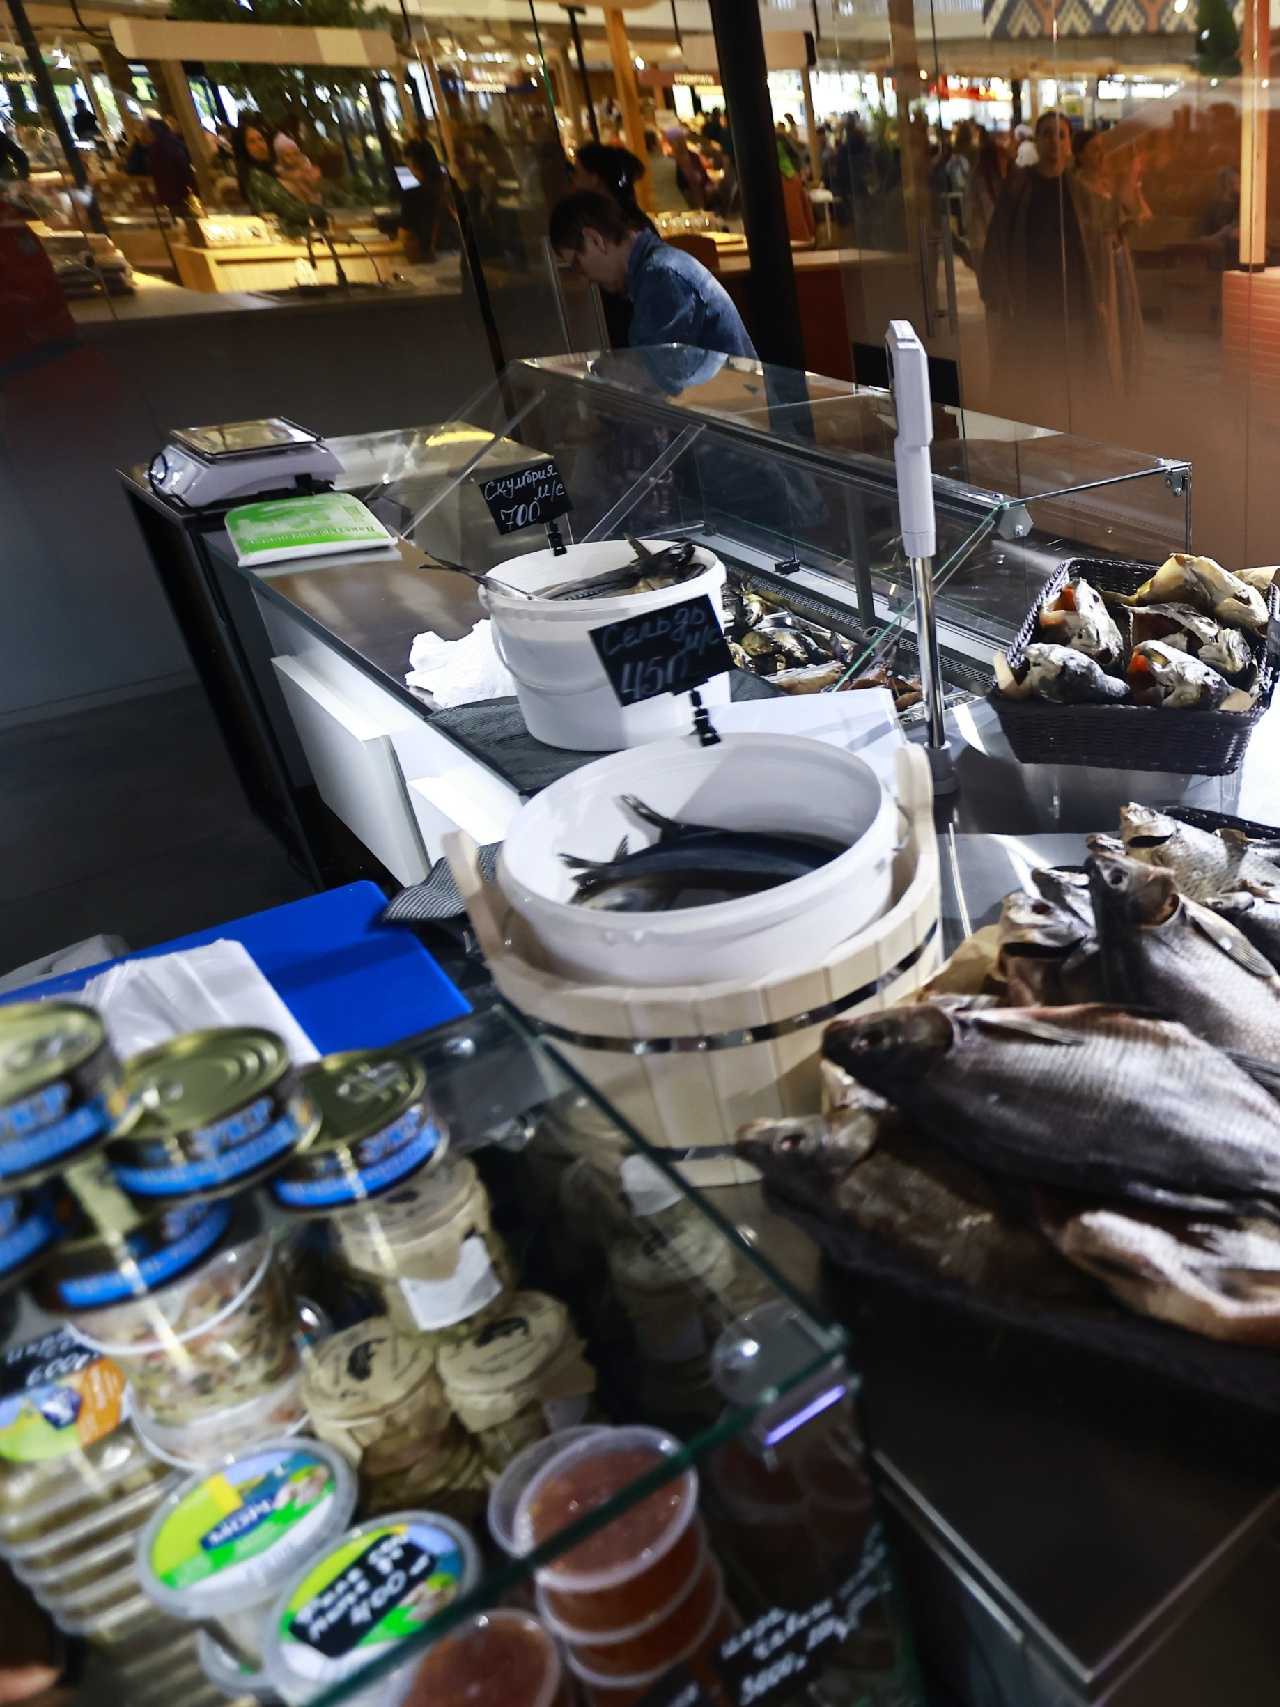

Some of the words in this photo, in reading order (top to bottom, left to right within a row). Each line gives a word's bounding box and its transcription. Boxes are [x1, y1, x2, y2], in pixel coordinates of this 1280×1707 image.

[484, 464, 557, 501] Скумбрия
[500, 501, 541, 531] 700
[602, 606, 706, 656] Сельдь
